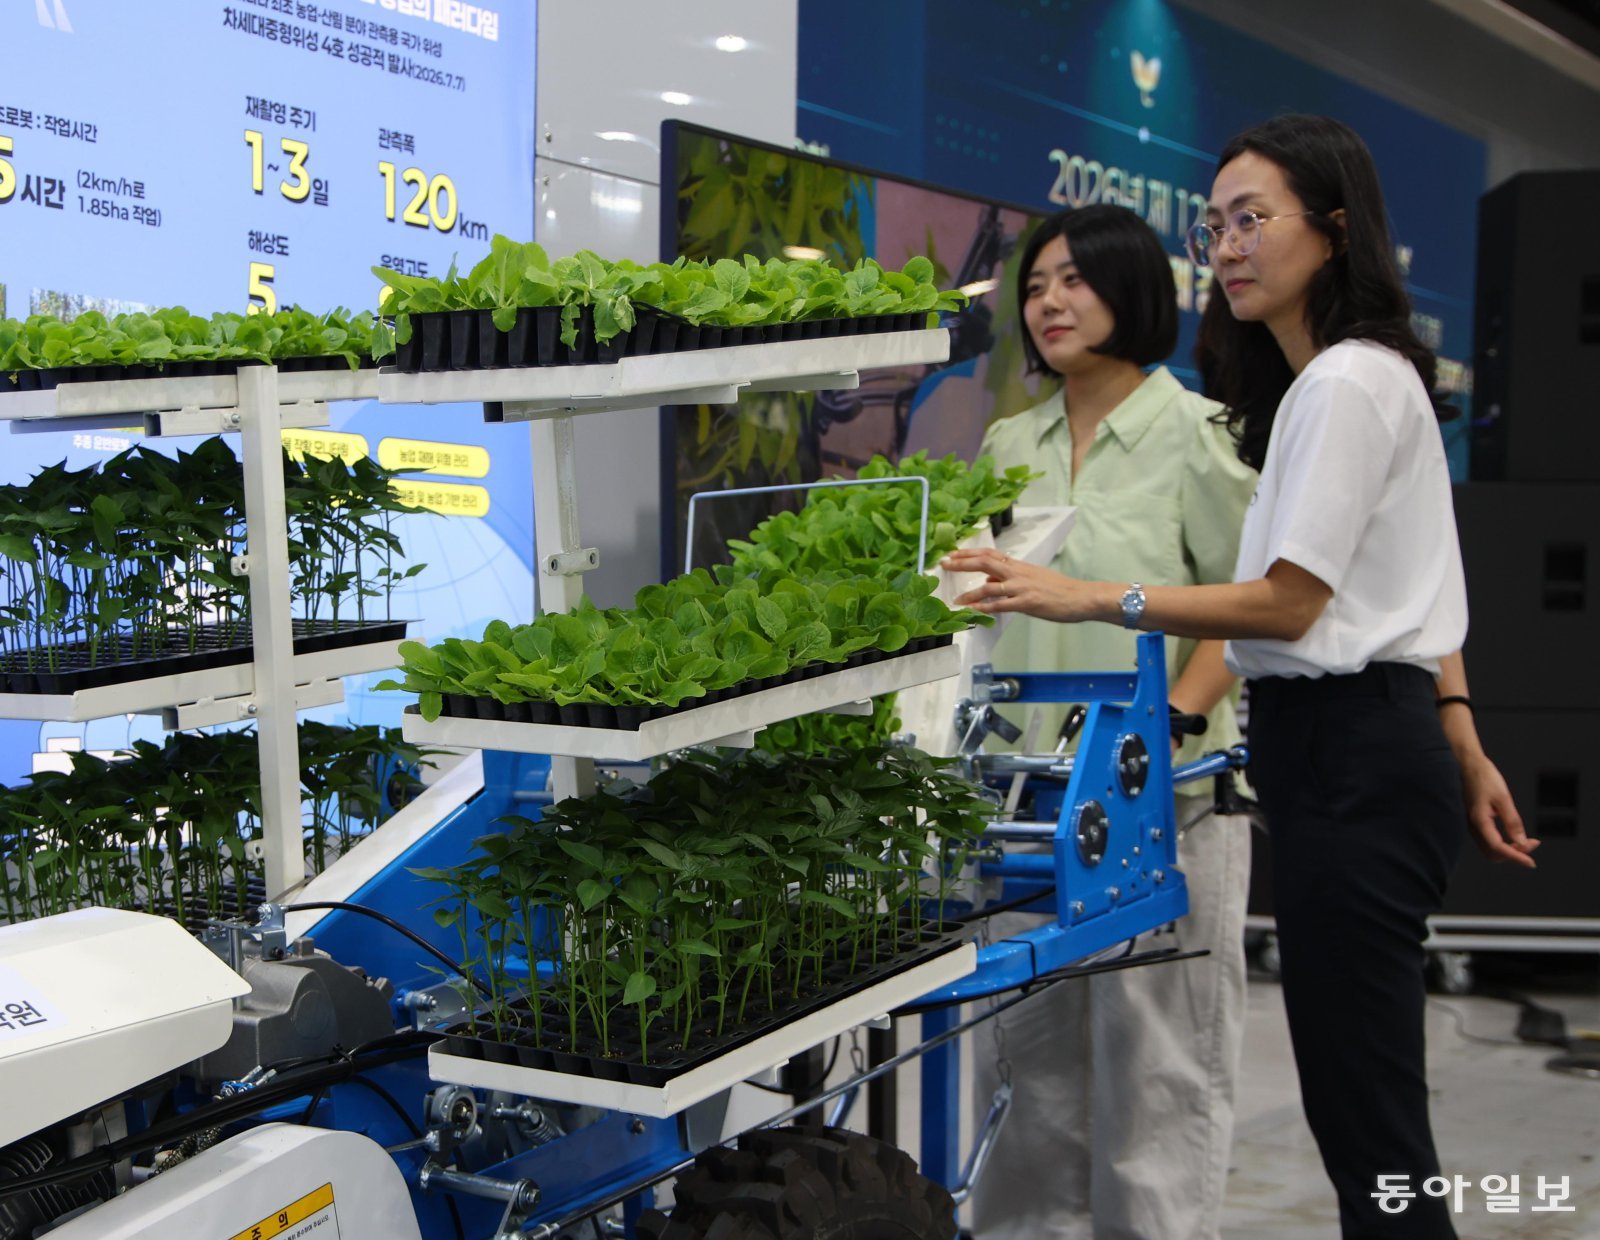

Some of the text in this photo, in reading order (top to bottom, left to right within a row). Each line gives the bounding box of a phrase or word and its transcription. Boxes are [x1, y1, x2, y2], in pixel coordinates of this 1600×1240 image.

[271, 0, 293, 16] 최초
[345, 15, 366, 36] 분야
[368, 22, 398, 46] 관측용
[401, 31, 421, 52] 국가
[423, 37, 442, 58] 위성
[433, 0, 498, 41] 패러다임
[223, 6, 466, 92] 차세대중형위성 4호 성공적 발사(2026.7.7)
[44, 114, 98, 143] 작업시간
[245, 95, 316, 132] 재촬영 주기
[378, 127, 415, 155] 관측폭
[21, 173, 66, 210] 시간
[77, 169, 145, 199] (2km/h로
[78, 195, 162, 228] 1.85ha 작업)
[247, 229, 290, 256] 해상도
